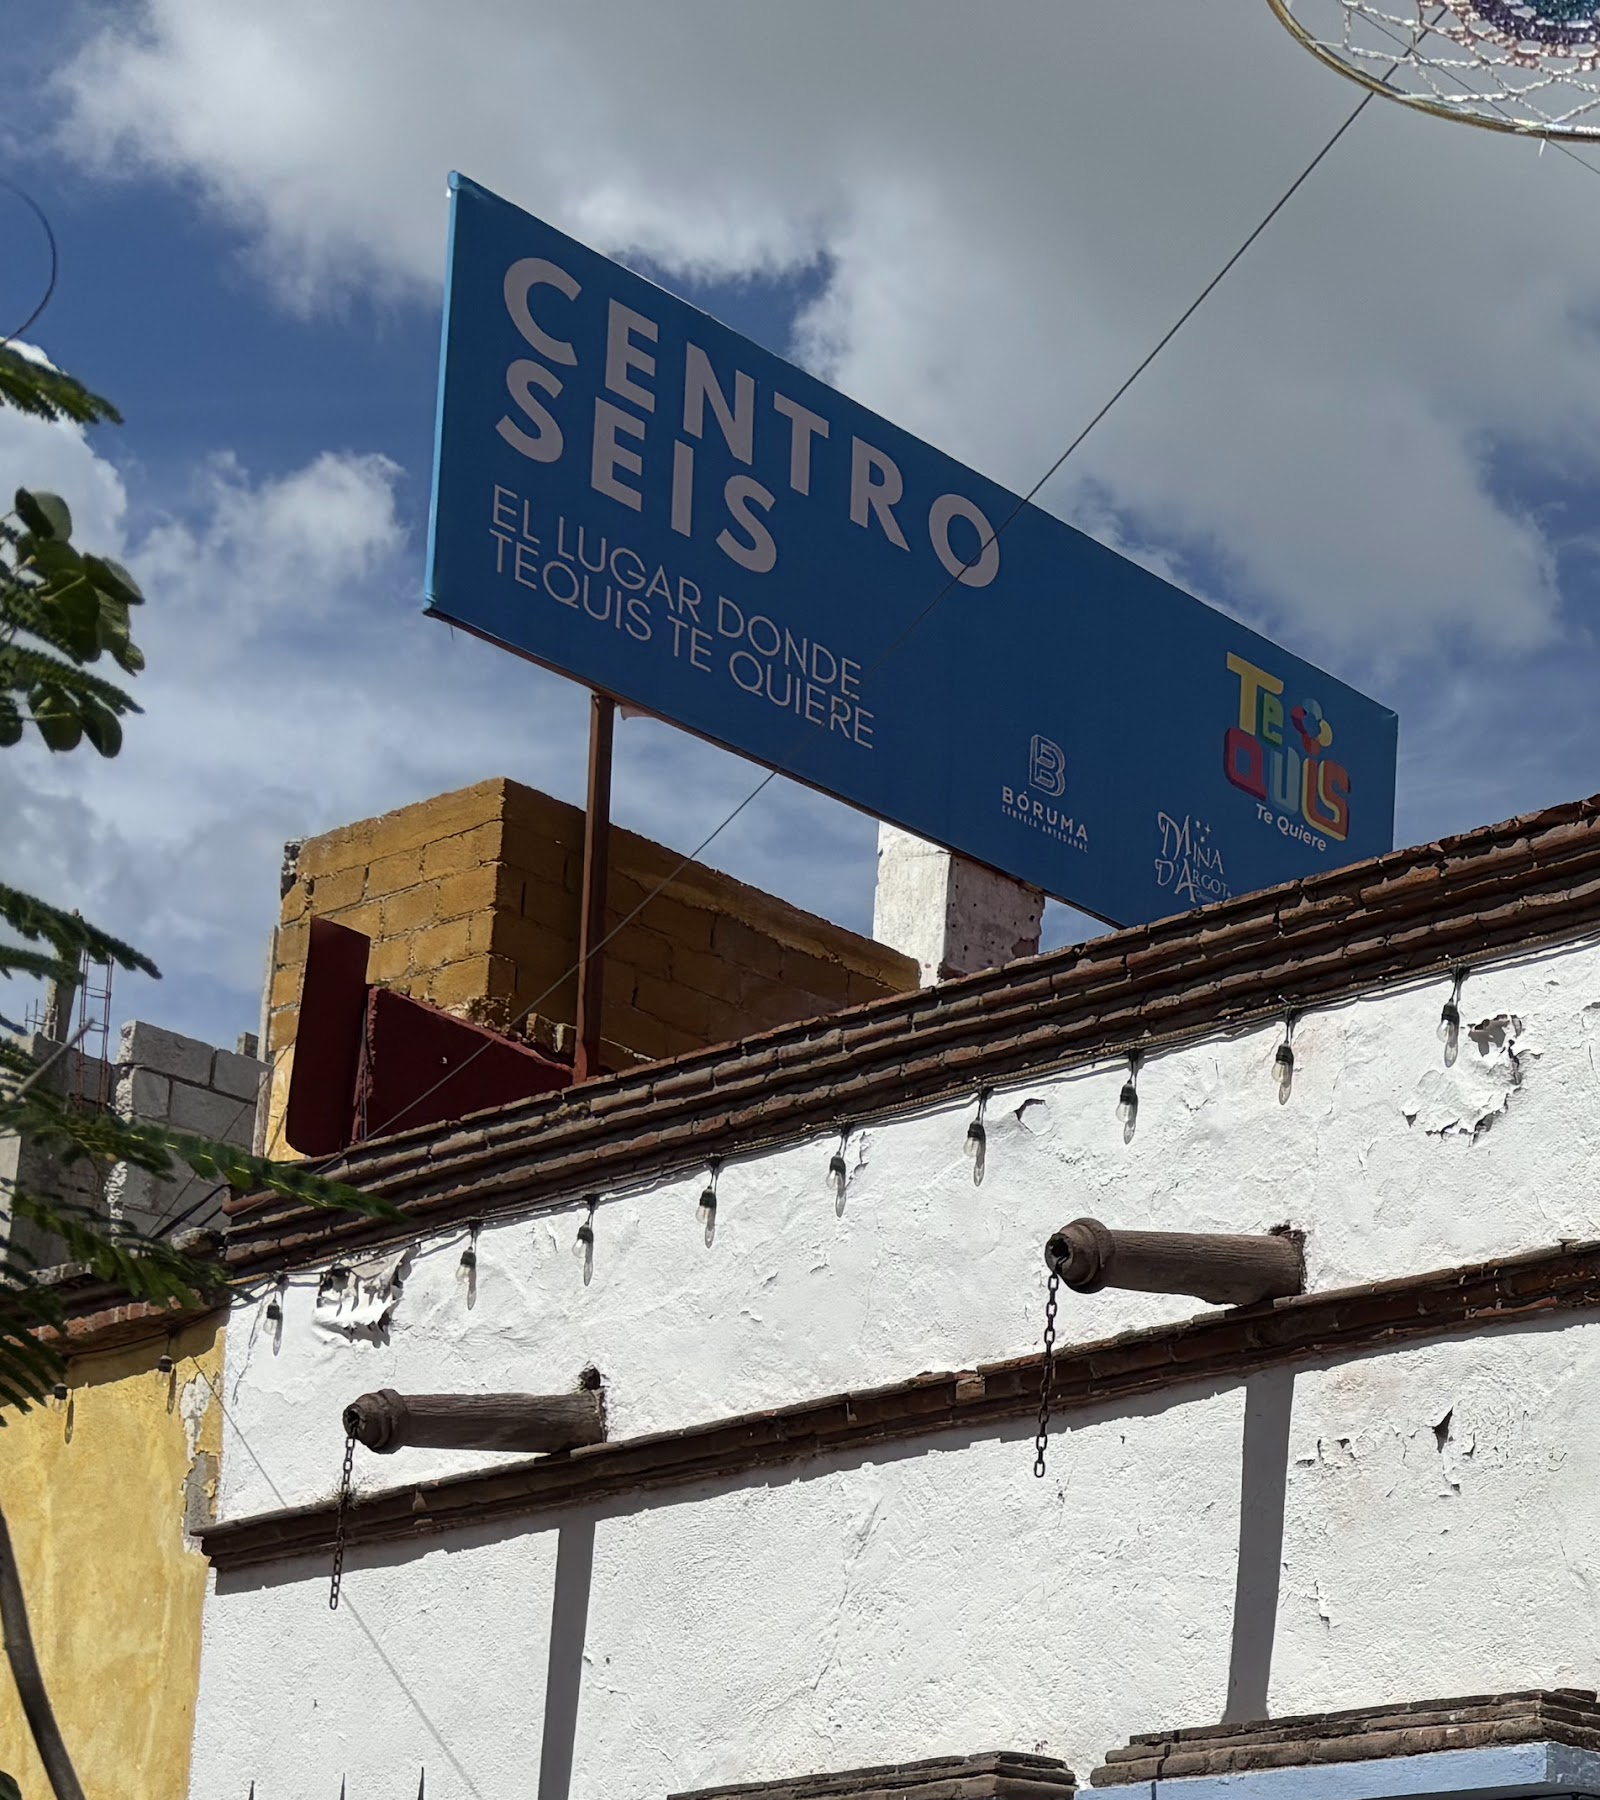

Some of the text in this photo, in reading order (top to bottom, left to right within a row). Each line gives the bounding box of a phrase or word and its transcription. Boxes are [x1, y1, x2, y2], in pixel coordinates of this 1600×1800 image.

[496, 359, 777, 573] SEIS
[503, 257, 1000, 588] CENTRO
[489, 529, 874, 749] TEQUIS TE QUIERE
[492, 484, 862, 700] EL LUGAR DONDE
[1002, 785, 1089, 841] BÓRUMA
[1256, 803, 1327, 851] Te Quiere
